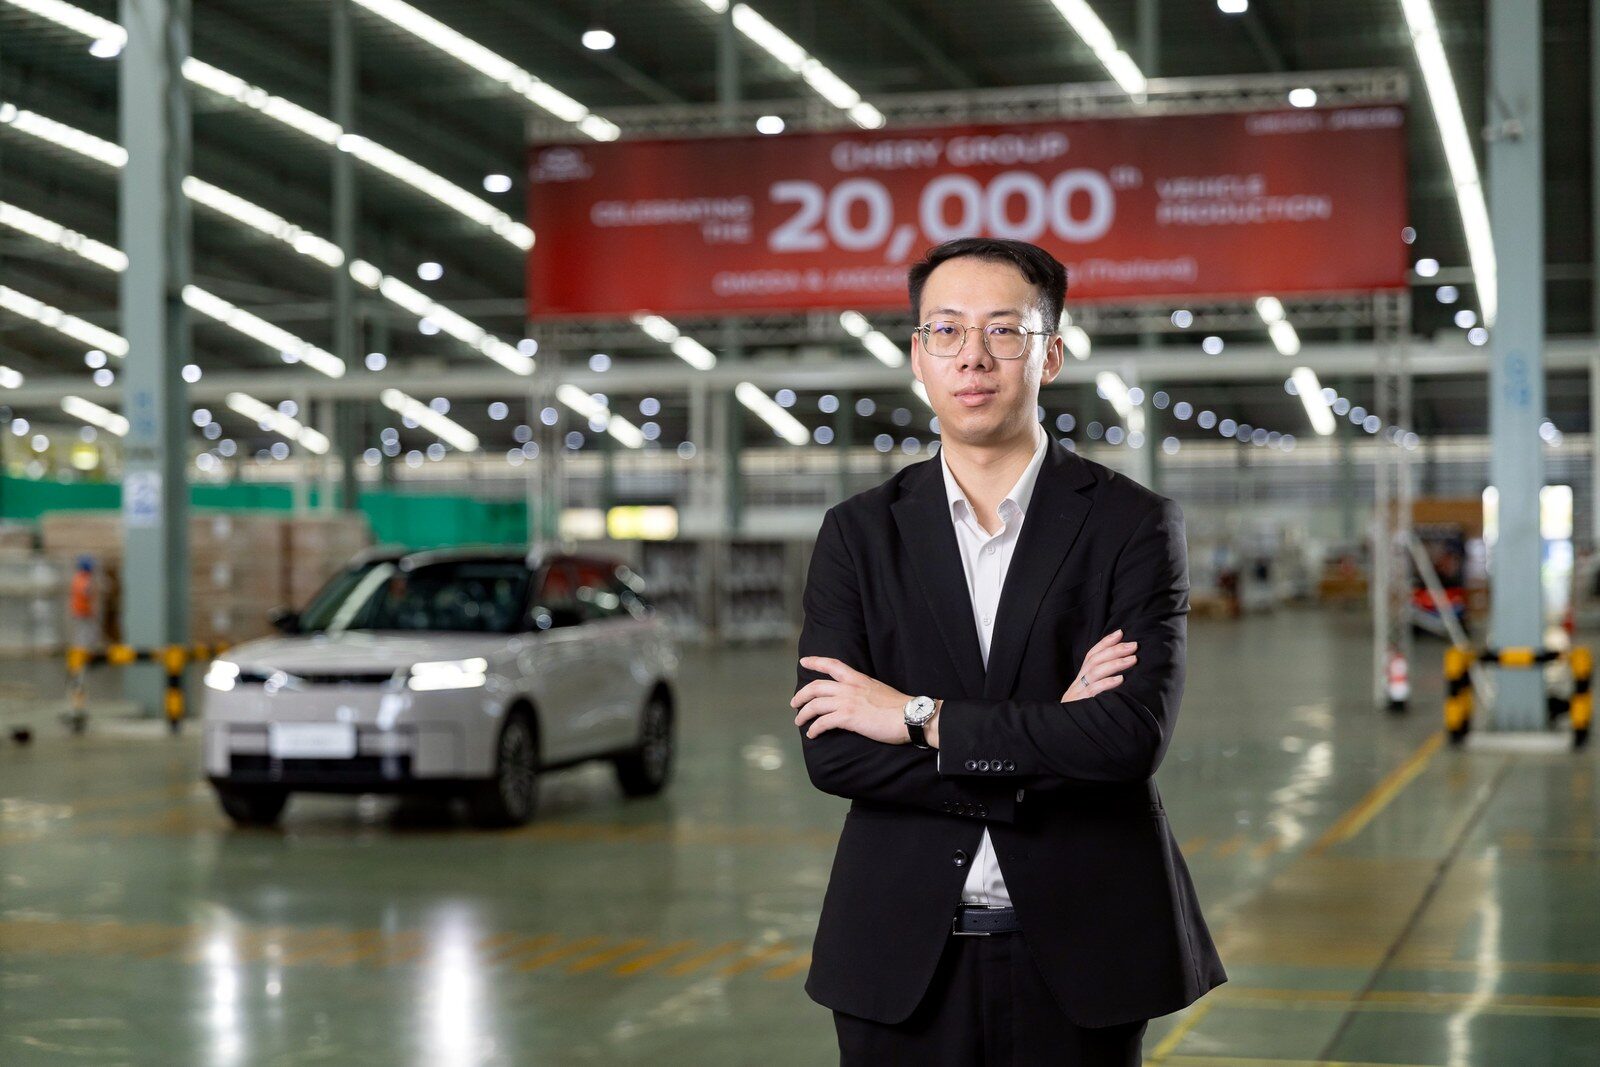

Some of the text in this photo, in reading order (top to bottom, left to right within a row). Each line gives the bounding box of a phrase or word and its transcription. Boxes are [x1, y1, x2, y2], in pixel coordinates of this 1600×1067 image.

[833, 134, 1068, 170] CHERY GROUP
[1156, 176, 1265, 199] VEHICLE
[591, 198, 752, 226] CELEBRATING
[1156, 197, 1331, 225] PRODUCTION
[702, 221, 752, 243] THE
